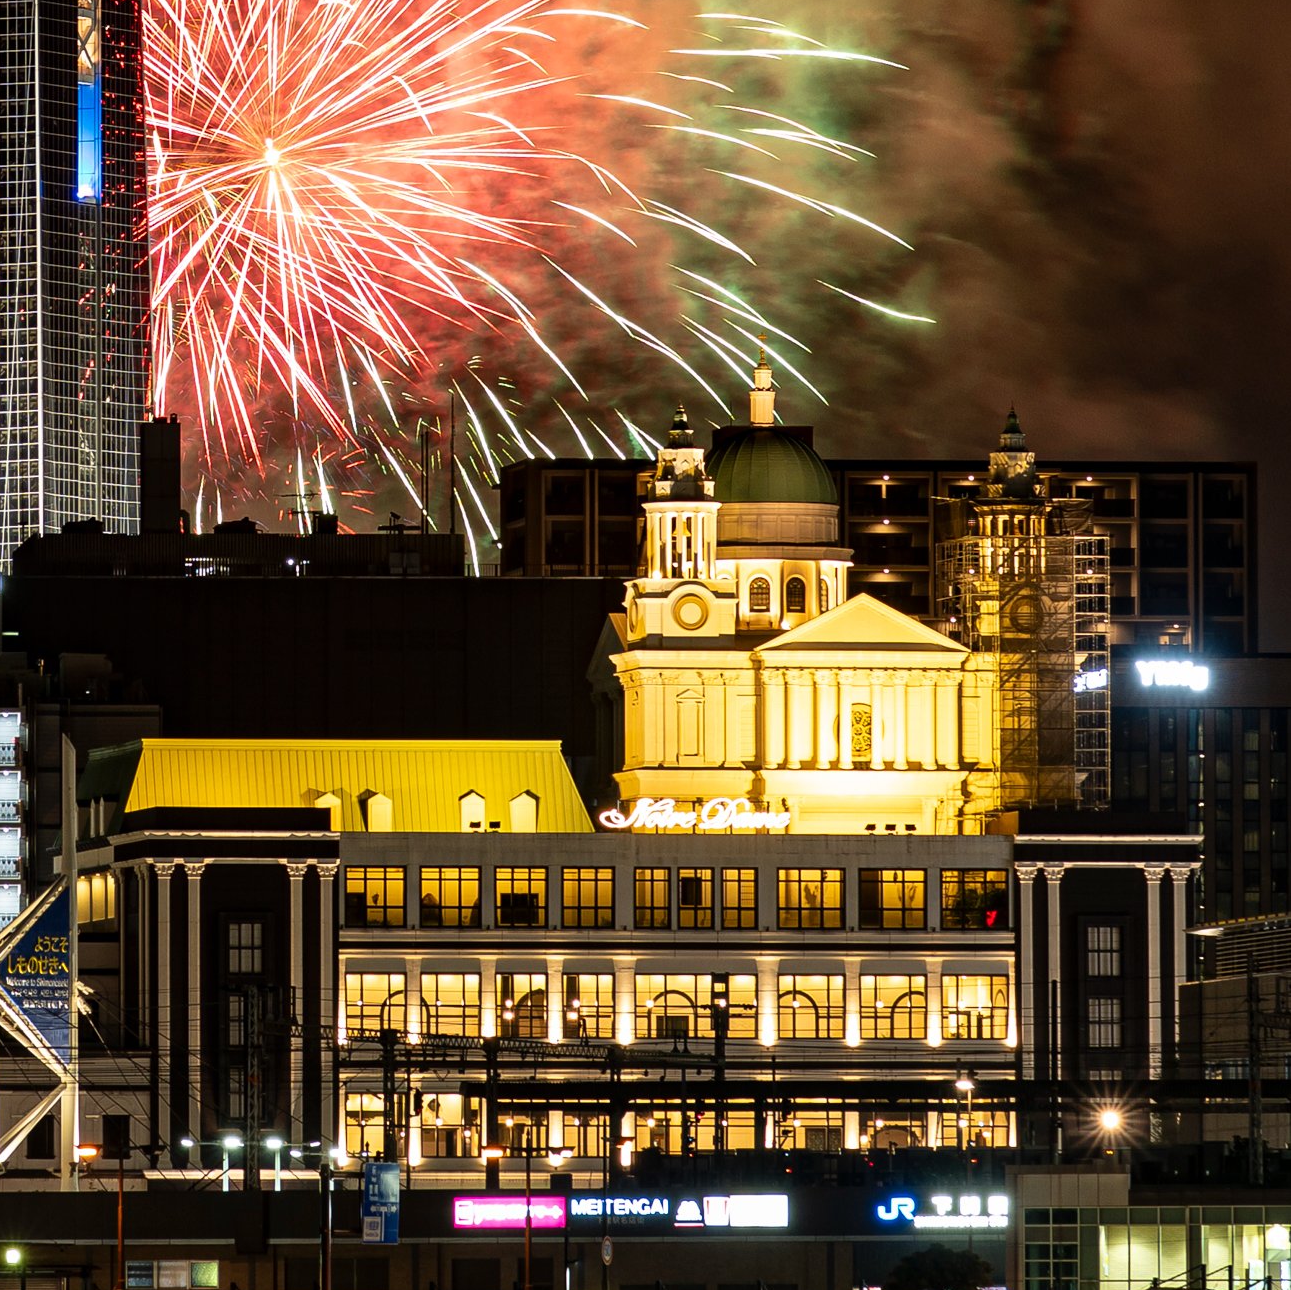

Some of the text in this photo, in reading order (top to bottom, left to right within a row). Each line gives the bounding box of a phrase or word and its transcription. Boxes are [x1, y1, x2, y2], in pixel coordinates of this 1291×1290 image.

[599, 797, 790, 829] Notre Dame
[35, 936, 69, 953] ようこそ
[7, 954, 69, 975] しものせきへ
[571, 1198, 668, 1215] MEITENGAI
[877, 1197, 916, 1220] JR
